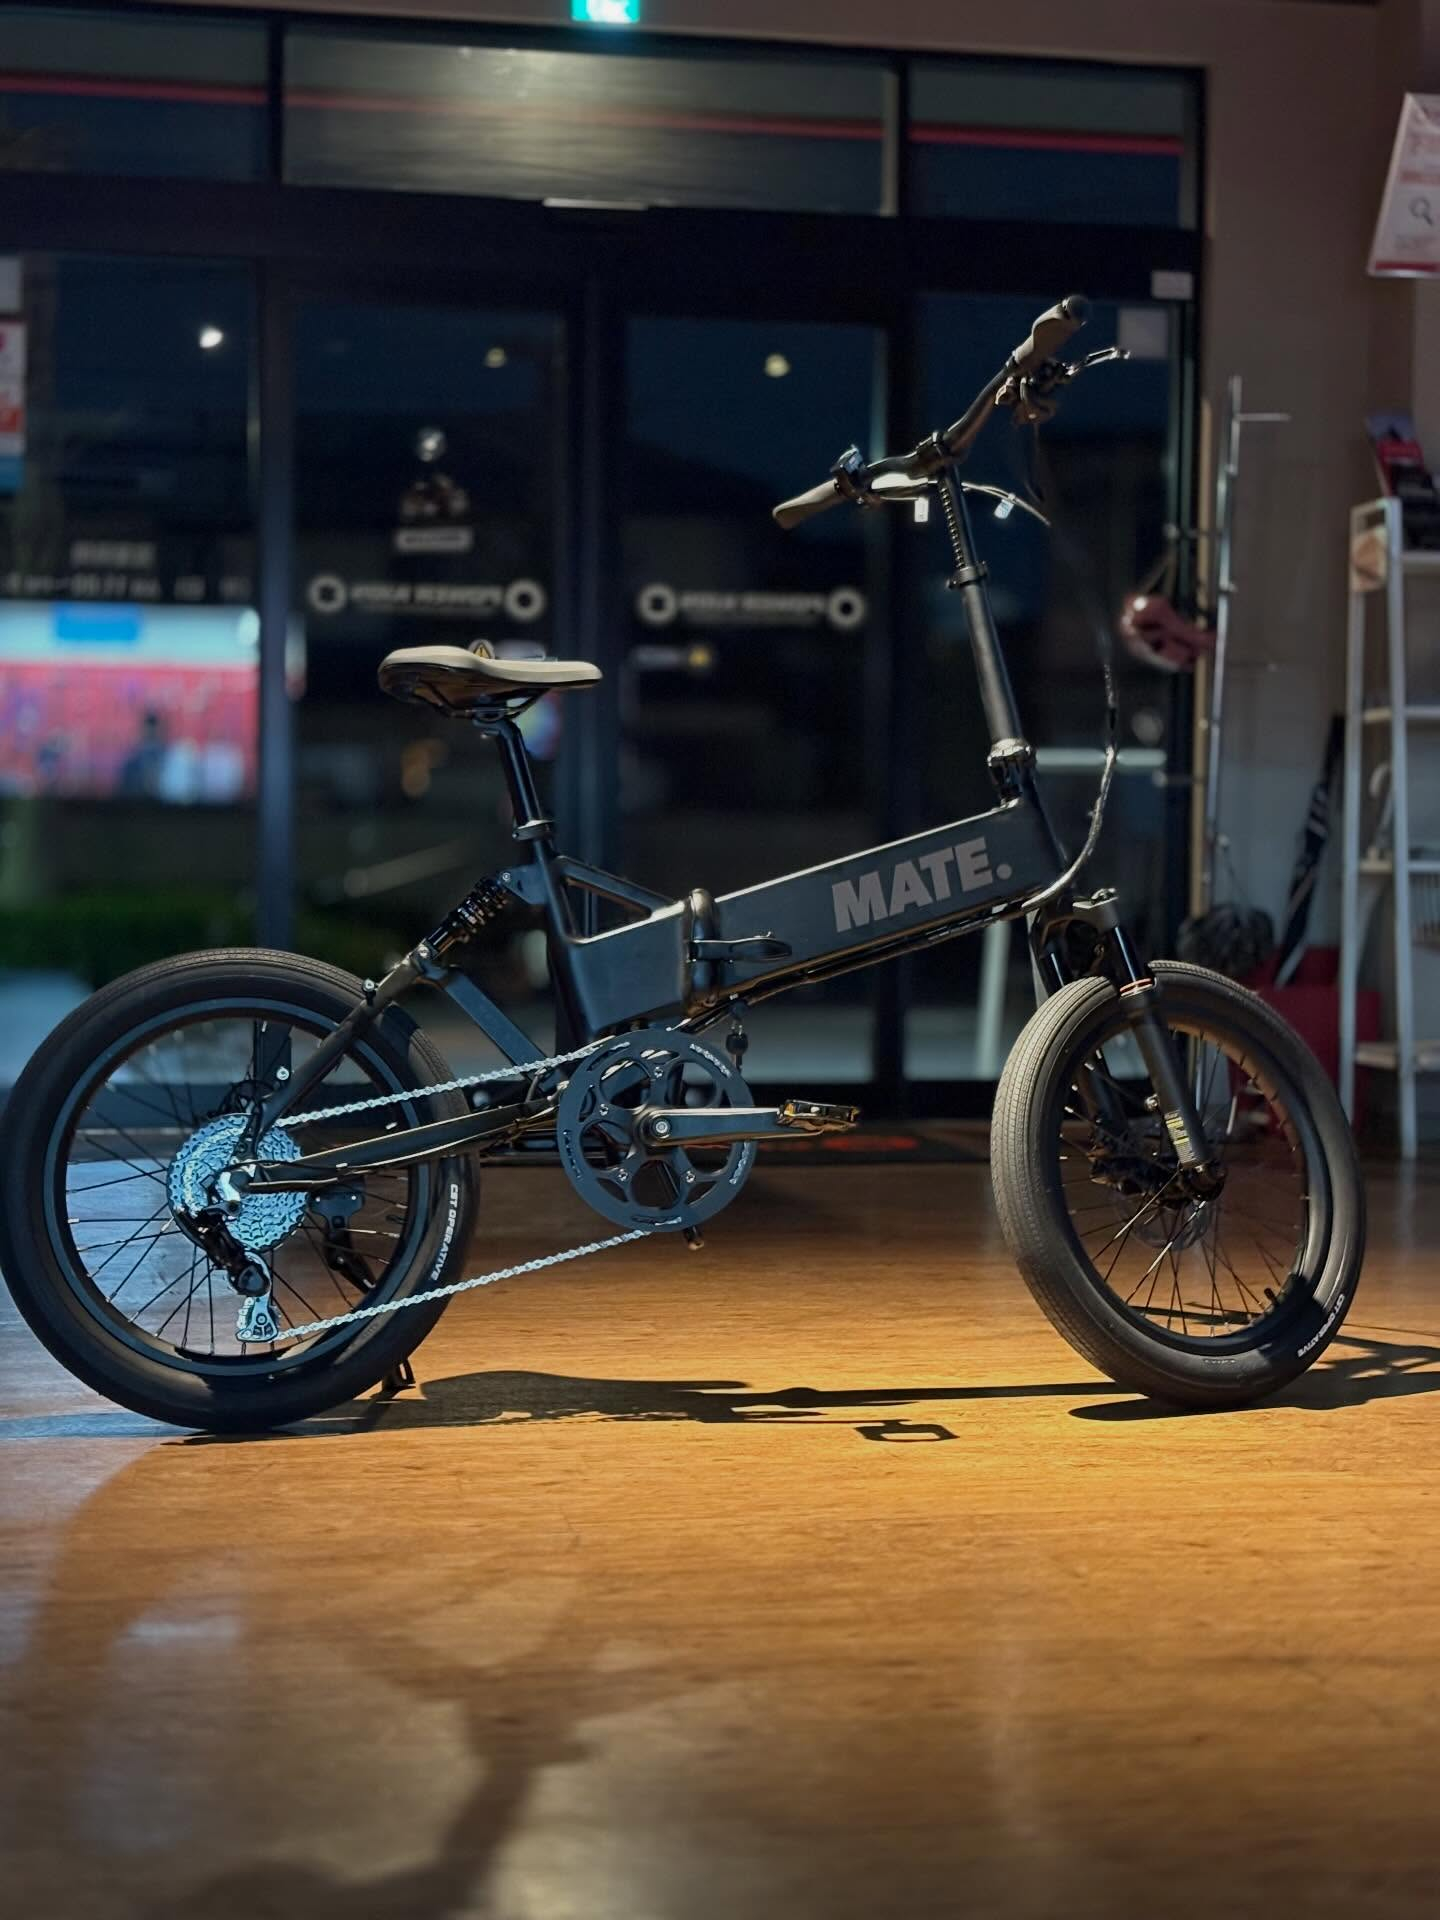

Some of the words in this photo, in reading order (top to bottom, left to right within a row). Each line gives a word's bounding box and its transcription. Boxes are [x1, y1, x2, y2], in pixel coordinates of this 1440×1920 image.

[832, 837, 1012, 933] MATE.
[450, 1184, 459, 1208] CST
[431, 1209, 457, 1280] OPERATIVE
